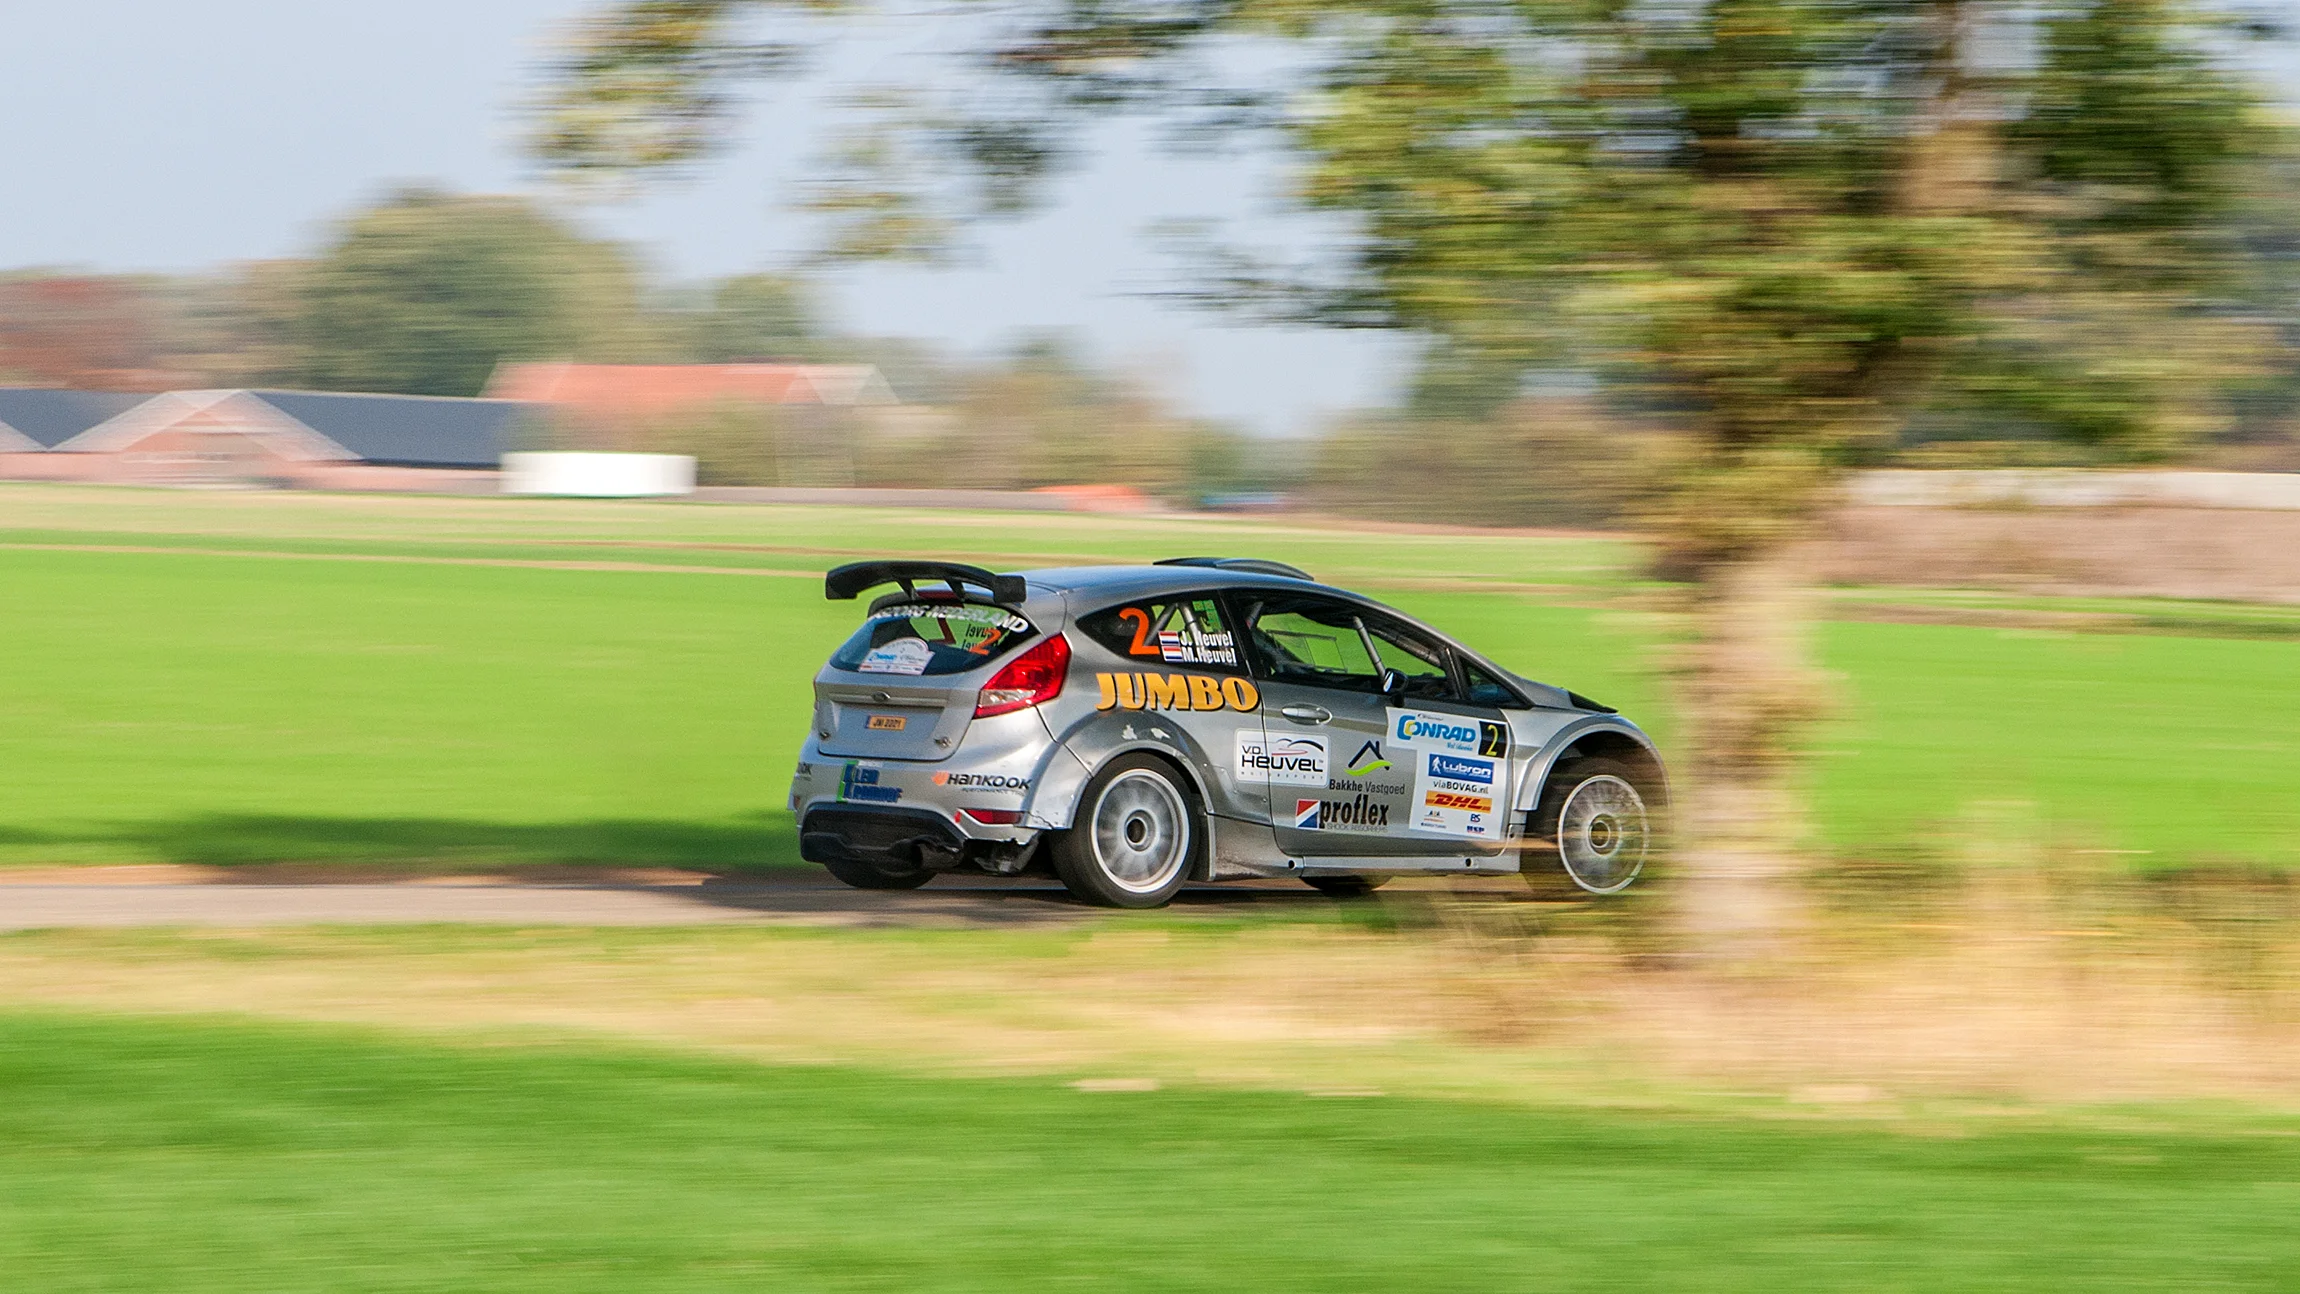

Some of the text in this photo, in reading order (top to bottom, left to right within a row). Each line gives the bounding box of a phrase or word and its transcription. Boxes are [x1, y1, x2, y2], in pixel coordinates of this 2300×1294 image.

[926, 604, 1029, 634] NEDERLAND
[1119, 607, 1161, 656] 2
[1180, 630, 1234, 647] J. Heuvel
[1095, 672, 1261, 713] JUMBO
[1397, 714, 1477, 743] CONRAD
[1485, 724, 1500, 756] 2
[1241, 745, 1264, 755] V.D.
[1442, 760, 1492, 777] Lubron
[947, 773, 1033, 790] HANKOOK
[1329, 778, 1406, 796] Bakkhe Vastgoed
[1433, 780, 1490, 795] viaBOVAG.nl
[1434, 793, 1484, 810] DHL
[1319, 793, 1389, 830] proflex
